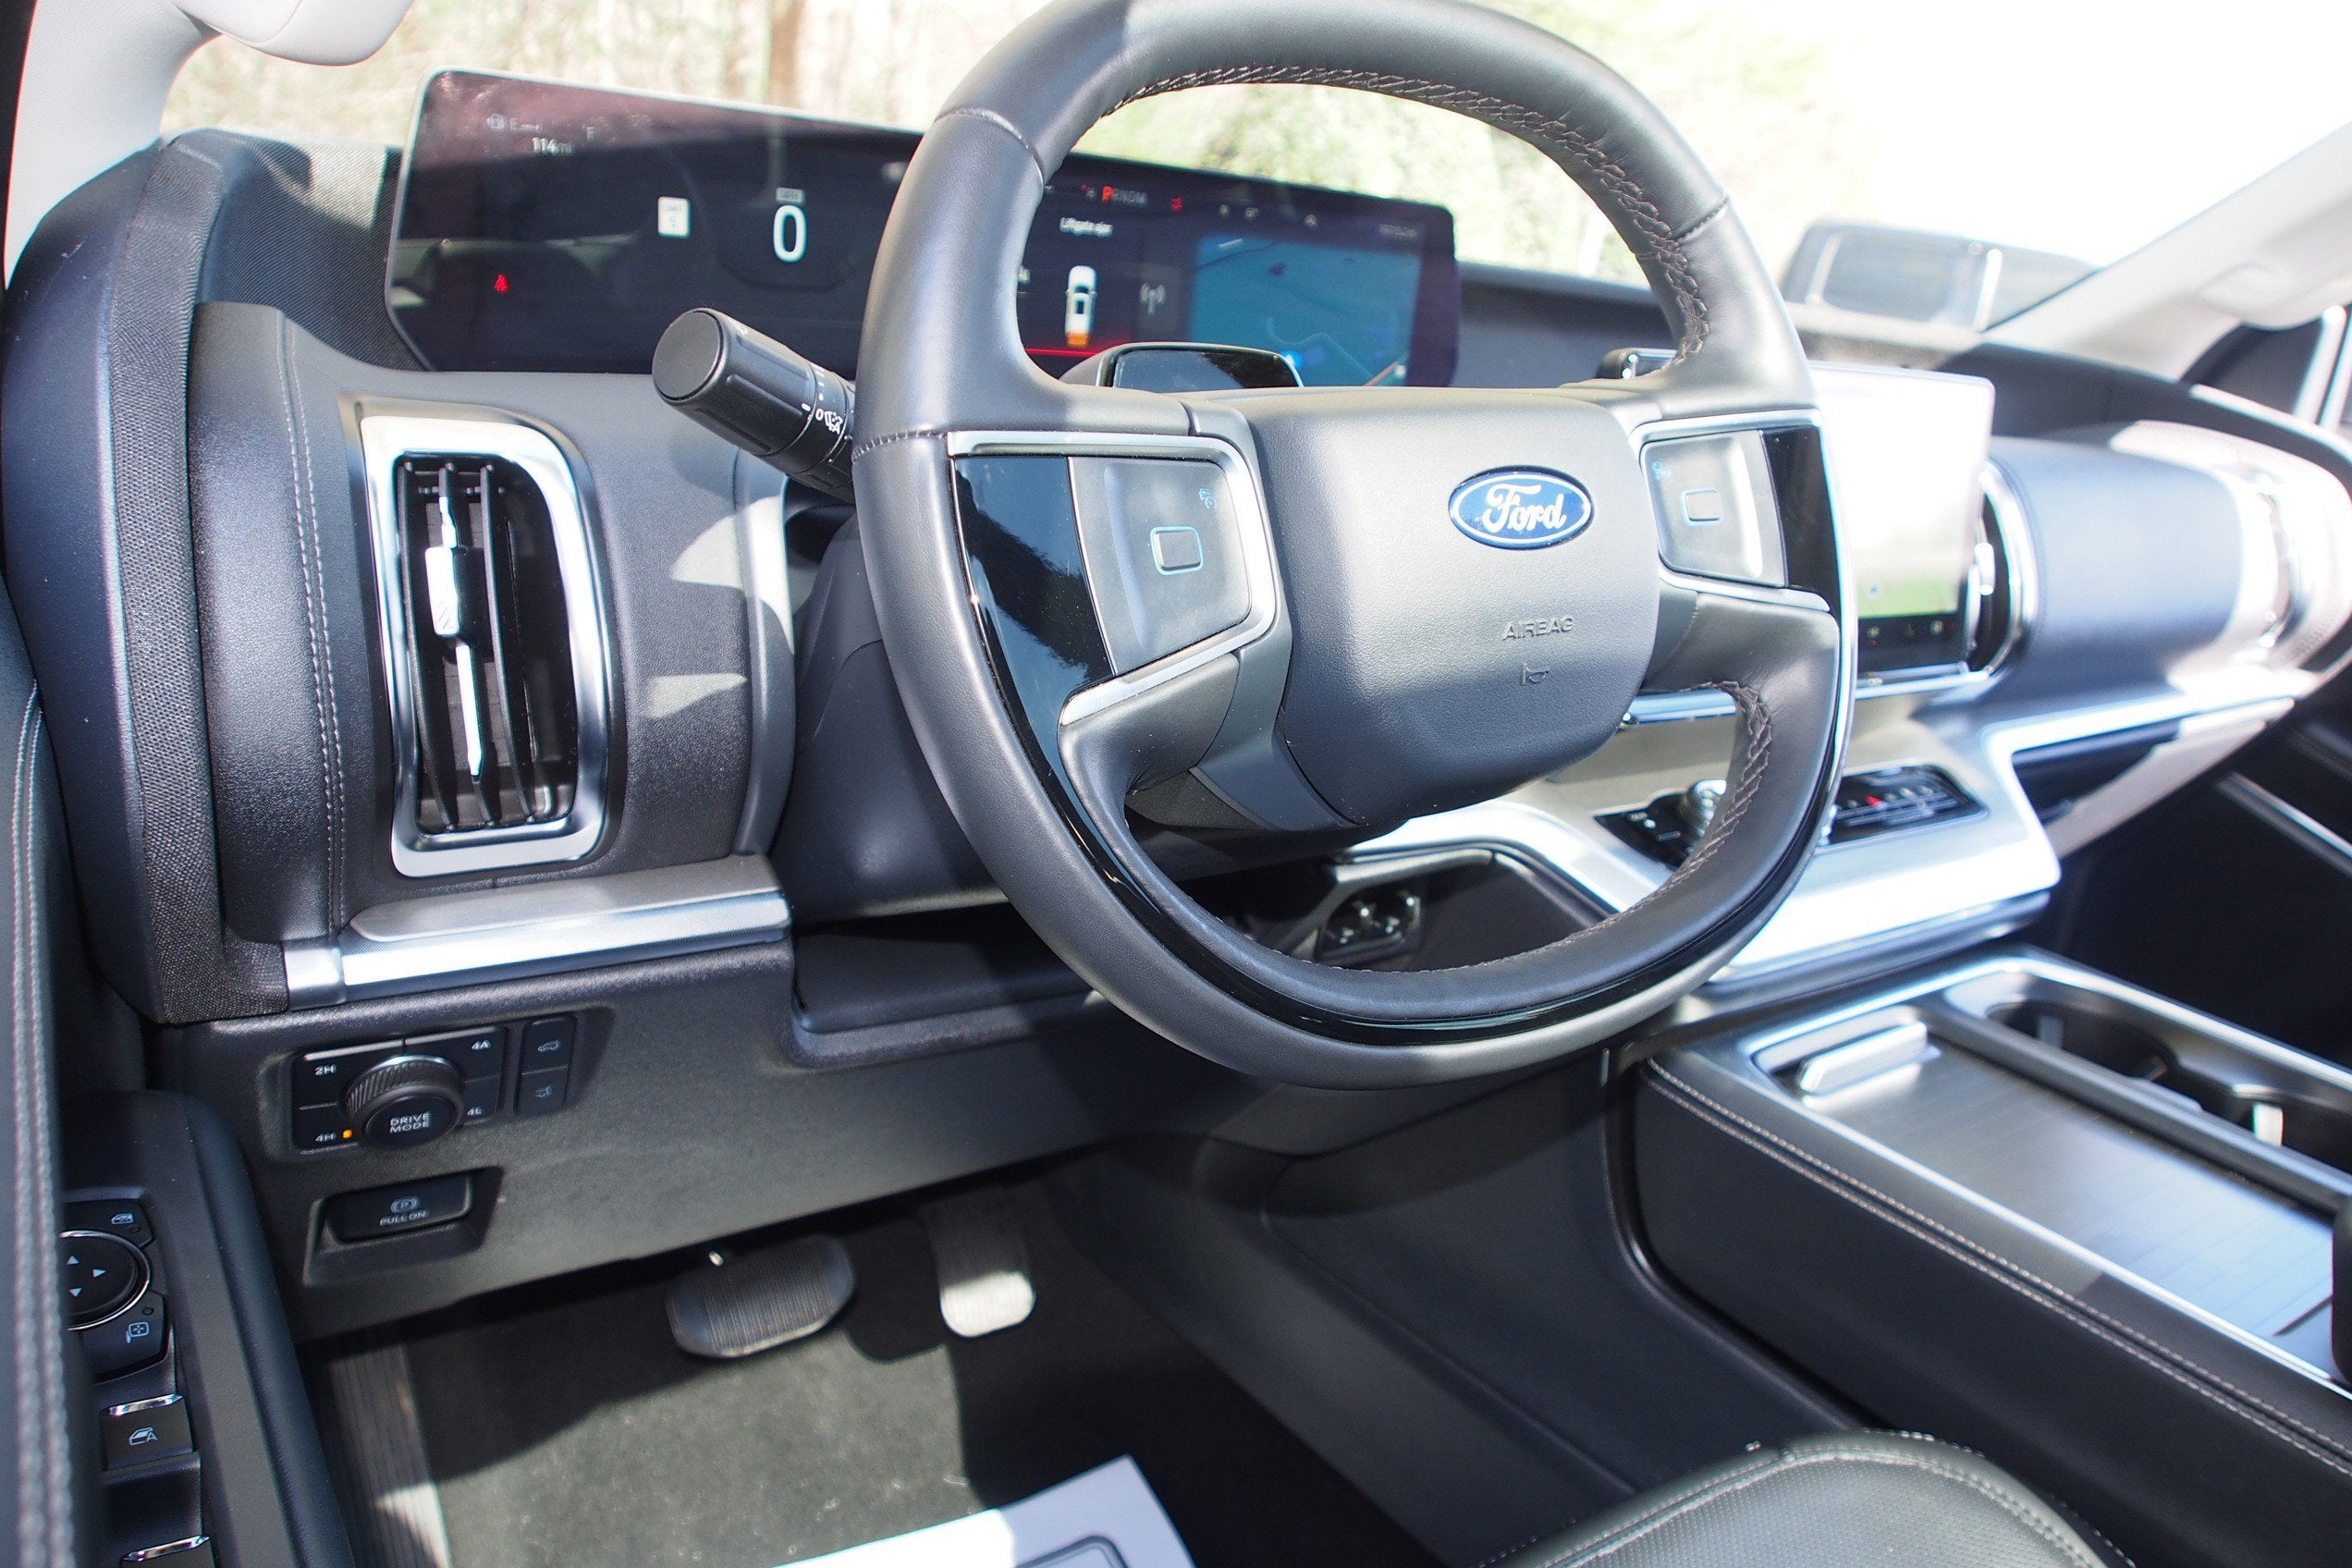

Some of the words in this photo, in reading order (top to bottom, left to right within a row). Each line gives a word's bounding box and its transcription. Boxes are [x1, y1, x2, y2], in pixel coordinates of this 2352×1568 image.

[773, 205, 807, 263] 0
[1482, 484, 1567, 533] Ford
[1502, 616, 1574, 641] AIRBAG
[471, 1039, 489, 1050] 4A
[314, 1065, 335, 1075] 2H
[467, 1107, 482, 1117] 4L
[390, 1112, 430, 1127] DRIVE
[389, 1121, 430, 1133] MODE
[315, 1133, 334, 1143] 4H
[380, 1216, 406, 1226] PULL
[408, 1211, 426, 1220] ON
